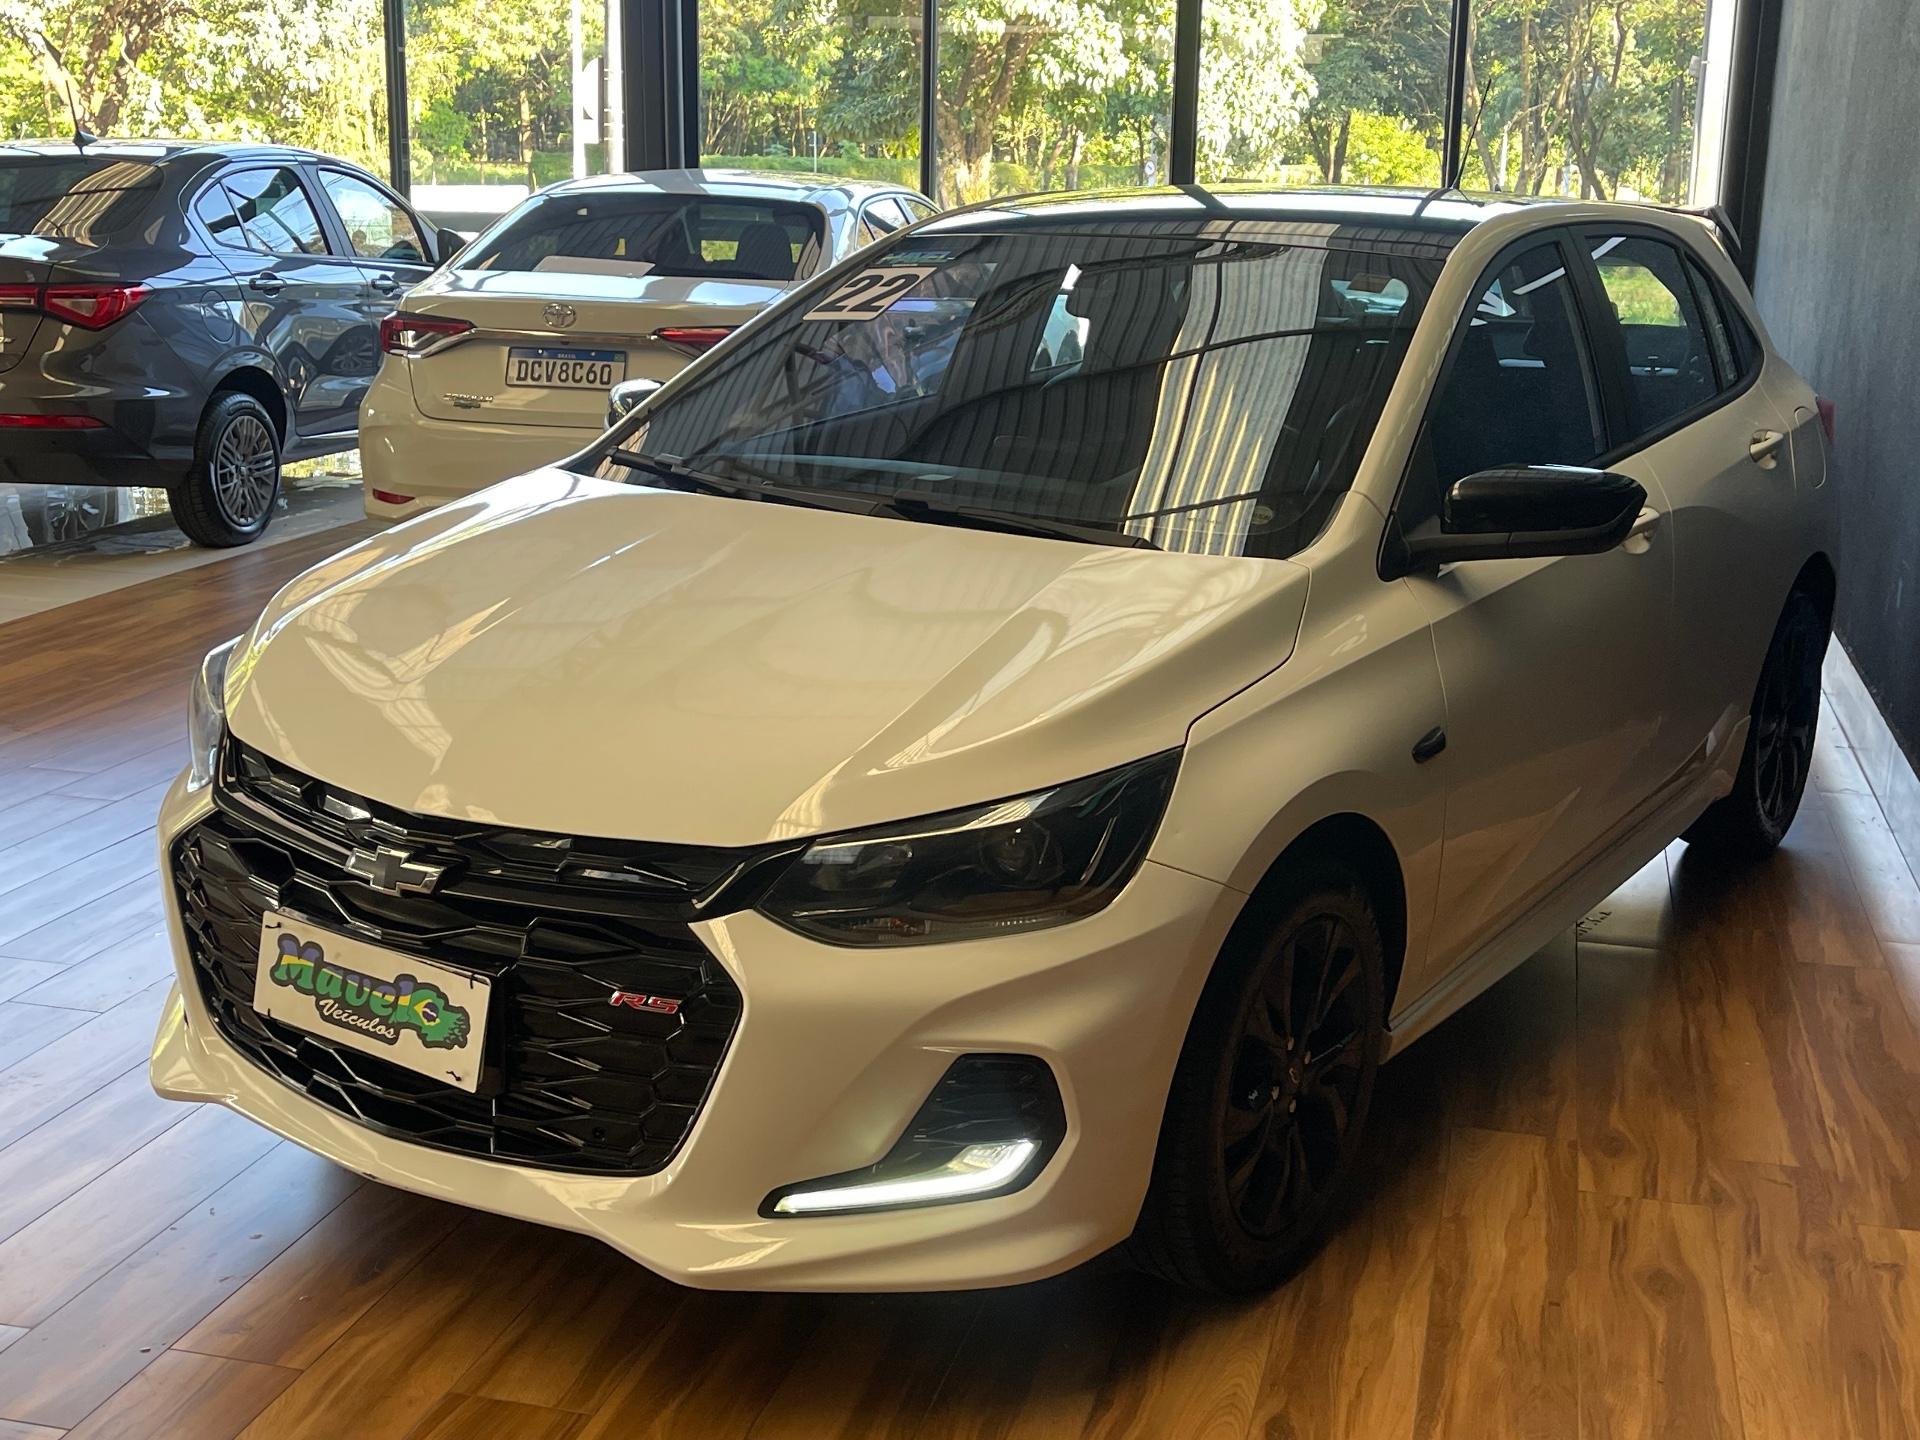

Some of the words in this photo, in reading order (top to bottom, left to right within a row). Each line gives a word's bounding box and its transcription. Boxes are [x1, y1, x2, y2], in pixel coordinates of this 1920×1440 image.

[812, 273, 920, 312] 22
[516, 360, 612, 385] DCV8C60
[608, 991, 682, 1014] RS
[319, 999, 396, 1039] Veículos
